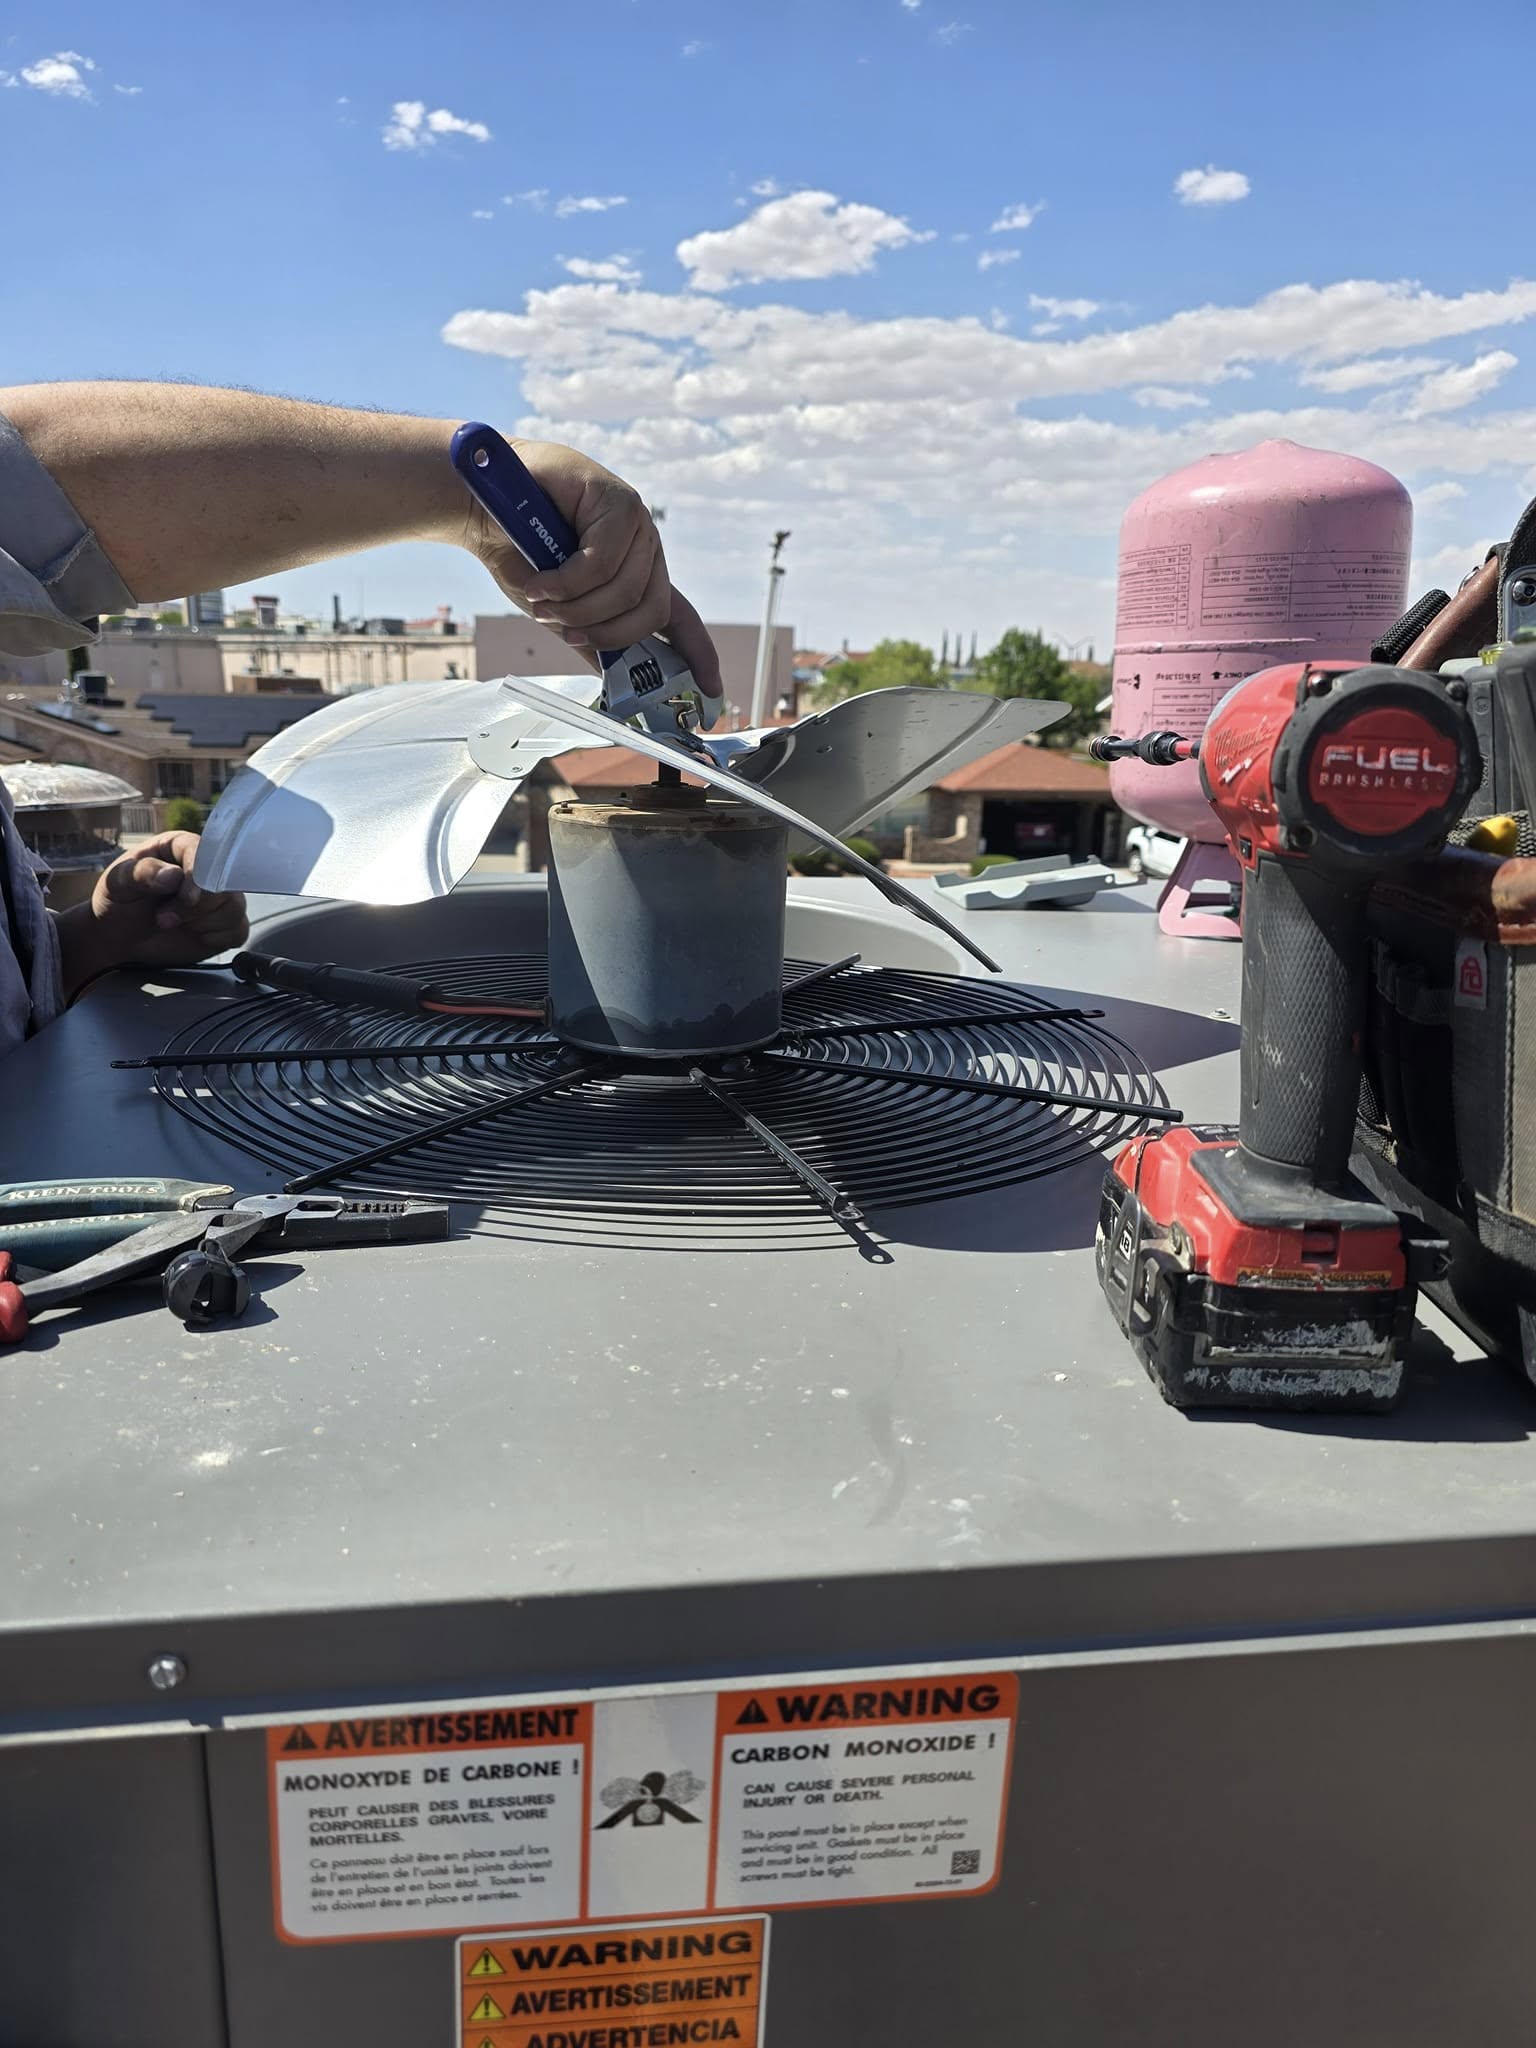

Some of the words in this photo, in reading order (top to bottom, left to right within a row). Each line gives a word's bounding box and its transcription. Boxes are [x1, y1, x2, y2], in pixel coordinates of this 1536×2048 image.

[528, 516, 559, 554] TOOLS
[1322, 744, 1450, 775] FUEL
[8, 1186, 80, 1200] KLEIN
[88, 1184, 161, 1195] TOOLS
[776, 1685, 1000, 1724] WARNING
[324, 1709, 578, 1749] AVERTISSEMENT
[730, 1744, 829, 1764] CARBON
[845, 1734, 976, 1758] MONOXIDE
[987, 1733, 995, 1749] !
[284, 1770, 411, 1792] MONOXYDE
[423, 1768, 450, 1783] DE
[462, 1760, 561, 1781] CARBONE
[572, 1759, 579, 1775] !
[744, 1783, 775, 1795] CAN
[785, 1779, 833, 1792] CAUSE
[841, 1775, 894, 1789] SEVERE
[901, 1770, 976, 1785] PERSONAL
[309, 1806, 348, 1819] PEUT
[358, 1802, 419, 1817] CAUSER
[429, 1800, 459, 1812] DES
[468, 1794, 555, 1809] BLESSURES
[743, 1796, 795, 1809] INJURY
[804, 1794, 825, 1804] OR
[833, 1790, 883, 1803] DEATH.
[309, 1816, 419, 1833] CORPORELLES
[428, 1812, 494, 1826] GRAVES,
[503, 1808, 548, 1821] VOIRE
[742, 1830, 764, 1840] This
[767, 1827, 800, 1842] panel
[803, 1826, 829, 1836] must
[832, 1823, 847, 1834] be
[850, 1822, 861, 1833] in
[864, 1820, 895, 1836] place
[897, 1818, 935, 1832] except
[937, 1816, 968, 1827] when
[310, 1832, 404, 1847] MORTELLES.
[741, 1842, 793, 1858] servicing
[827, 1837, 872, 1849] Gaskets
[875, 1836, 900, 1846] must
[903, 1833, 918, 1844] be
[921, 1832, 931, 1843] in
[934, 1830, 965, 1844] place
[310, 1859, 328, 1870] Ce
[332, 1856, 386, 1871] panneau
[390, 1852, 414, 1864] doit
[417, 1851, 440, 1863] être
[443, 1852, 459, 1862] en
[462, 1848, 496, 1863] place
[499, 1845, 525, 1858] sauf
[528, 1844, 549, 1857] lors
[739, 1857, 763, 1869] and
[766, 1856, 792, 1867] must
[795, 1854, 810, 1865] be
[813, 1853, 823, 1864] in
[827, 1851, 857, 1865] good
[921, 1845, 938, 1855] All
[310, 1871, 326, 1884] de
[393, 1867, 410, 1879] de
[453, 1863, 470, 1875] les
[473, 1862, 505, 1877] joints
[508, 1858, 552, 1871] doivent
[739, 1872, 778, 1883] screws
[781, 1869, 806, 1880] must
[810, 1867, 824, 1878] be
[311, 1886, 334, 1898] être
[338, 1887, 353, 1896] en
[356, 1882, 392, 1898] place
[395, 1882, 406, 1892] et
[409, 1882, 424, 1892] en
[428, 1879, 451, 1890] bon
[489, 1875, 525, 1887] Toutes
[529, 1873, 546, 1884] les
[312, 1901, 328, 1913] vis
[332, 1898, 376, 1912] doivent
[380, 1895, 402, 1908] être
[406, 1897, 421, 1906] en
[424, 1893, 458, 1908] place
[461, 1892, 474, 1902] et
[510, 1930, 753, 1971] WARNING
[510, 1973, 752, 2016] AVERTISSEMENT
[526, 2016, 741, 2048] ADVERTENCIA
